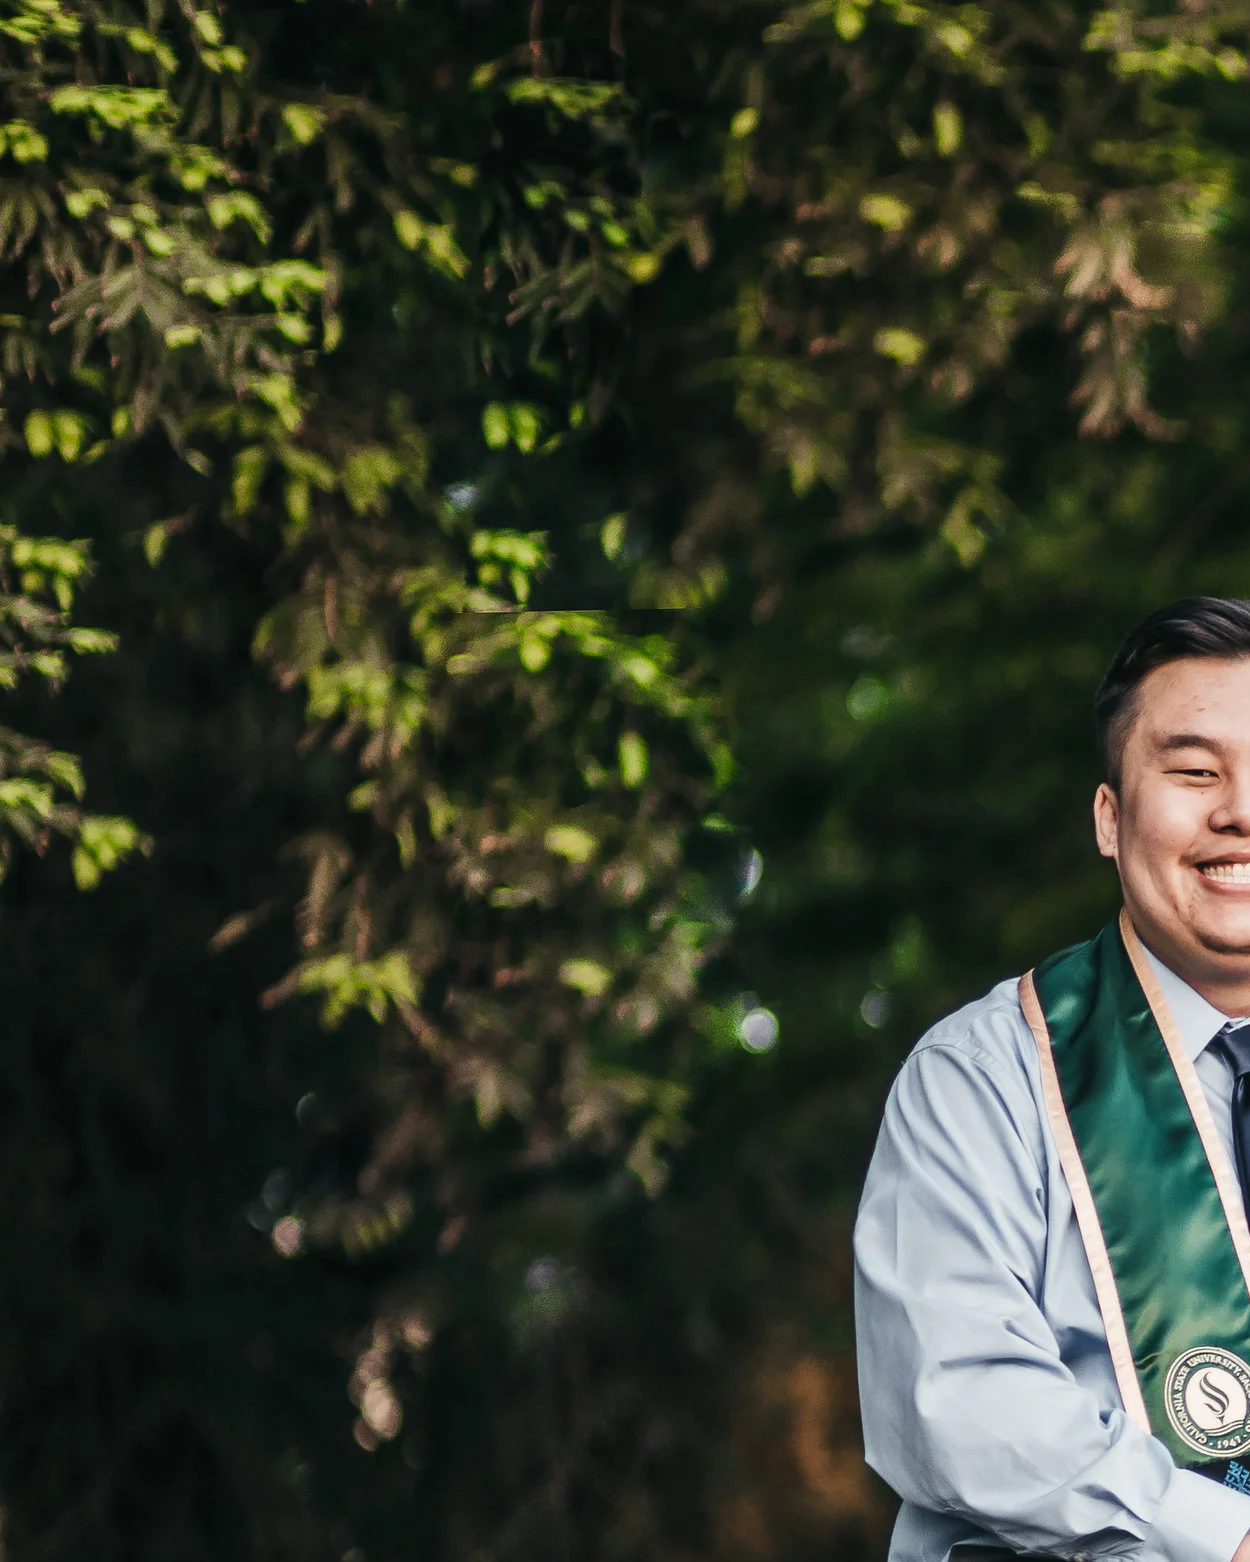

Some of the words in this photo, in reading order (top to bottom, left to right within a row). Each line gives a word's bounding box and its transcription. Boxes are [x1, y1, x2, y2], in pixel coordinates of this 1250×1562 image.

[1174, 1365, 1190, 1391] STATE
[1173, 1392, 1207, 1444] CALIFORNIA
[1217, 1435, 1241, 1449] 1947
